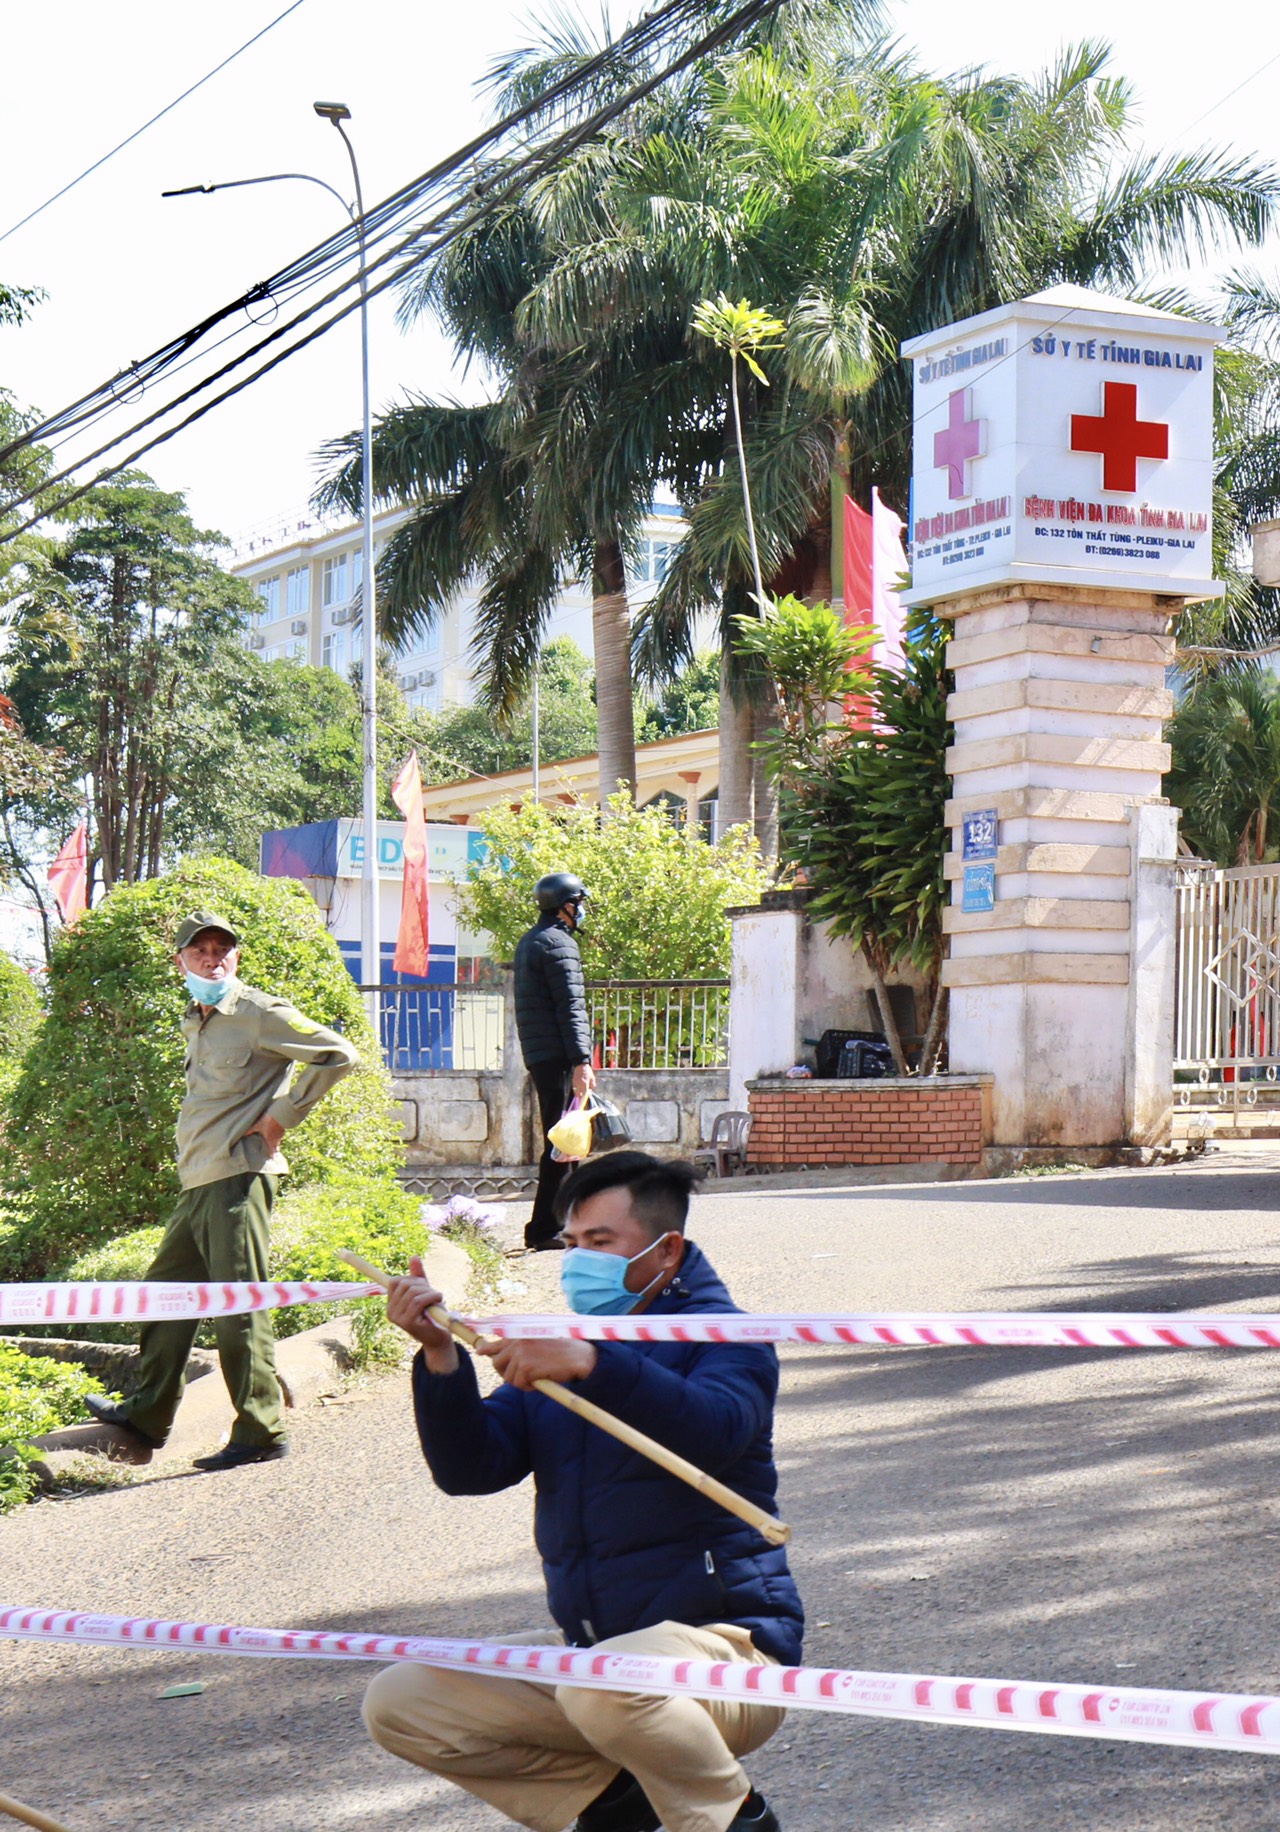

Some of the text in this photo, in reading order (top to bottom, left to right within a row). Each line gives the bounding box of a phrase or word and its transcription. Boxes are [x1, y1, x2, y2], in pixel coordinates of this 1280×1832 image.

[1032, 332, 1056, 355] SỞ
[1061, 340, 1071, 357] Y
[1076, 338, 1097, 360] TẾ
[1143, 349, 1172, 368] GIA
[1175, 353, 1202, 371] LAI
[1058, 496, 1085, 524] VIỆN
[1106, 504, 1136, 525] KHOA
[1167, 510, 1184, 529] GIA
[1189, 512, 1207, 532] LAI
[1050, 528, 1065, 538] 132
[1182, 540, 1195, 549] LAI
[1145, 550, 1160, 559] 088
